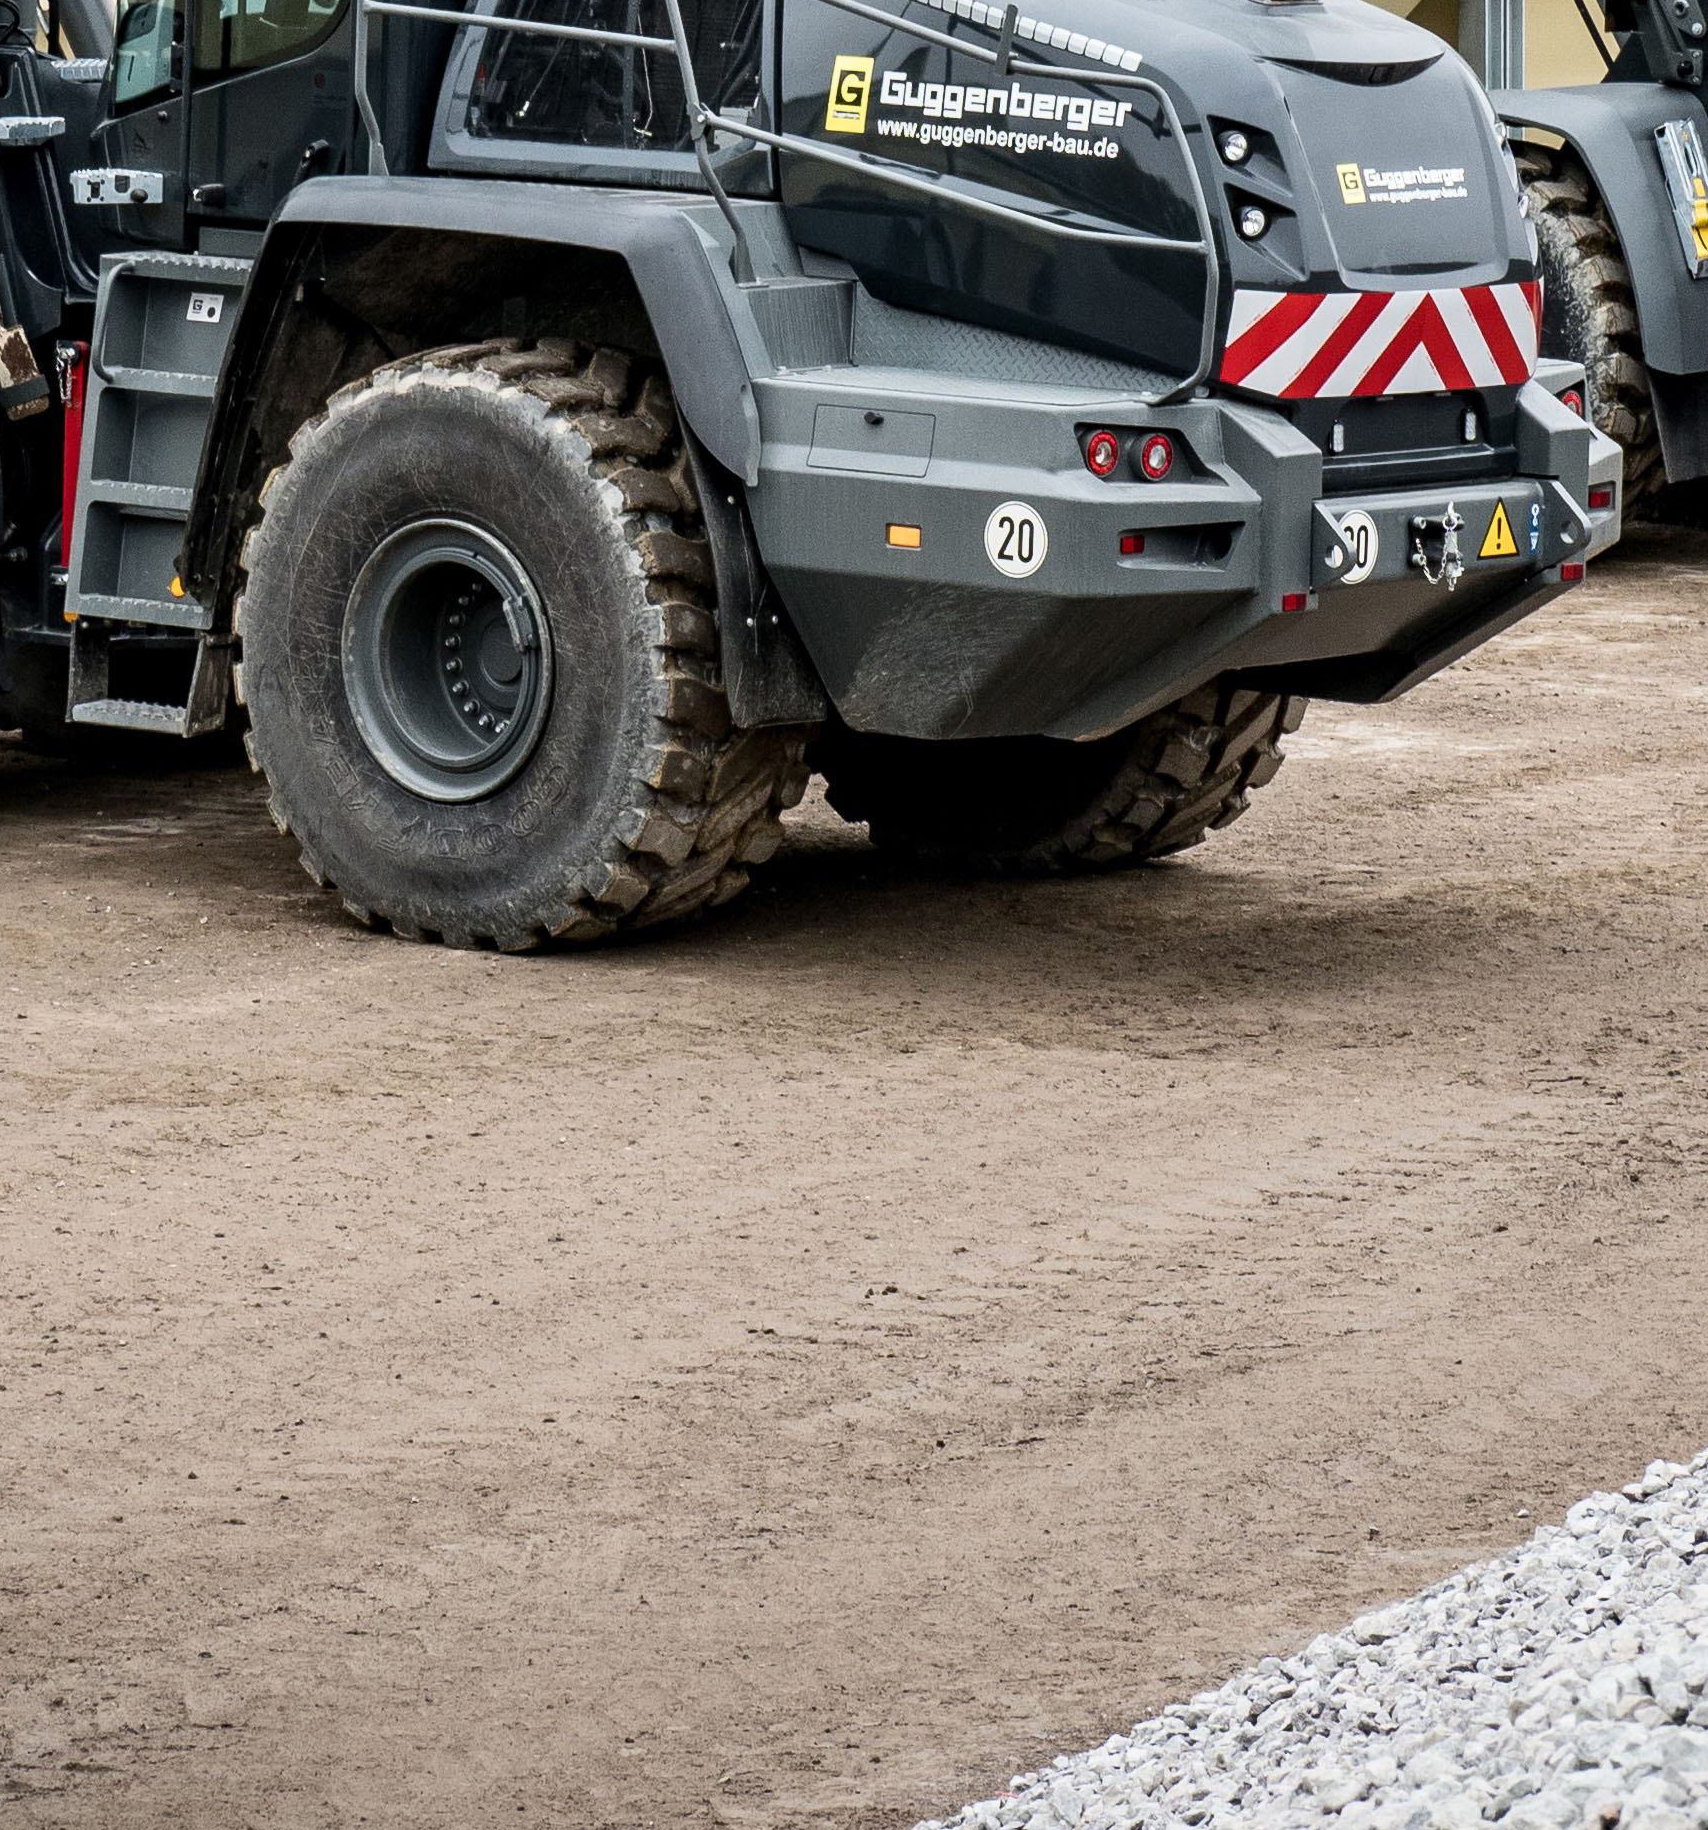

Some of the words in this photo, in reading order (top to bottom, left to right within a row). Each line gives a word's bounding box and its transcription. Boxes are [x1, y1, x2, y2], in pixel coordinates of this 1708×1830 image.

[880, 70, 1132, 131] Guggenberger
[877, 118, 1120, 160] www.guggenberger-bau.de
[1363, 166, 1465, 190] Guggenberger
[997, 516, 1035, 564] 20
